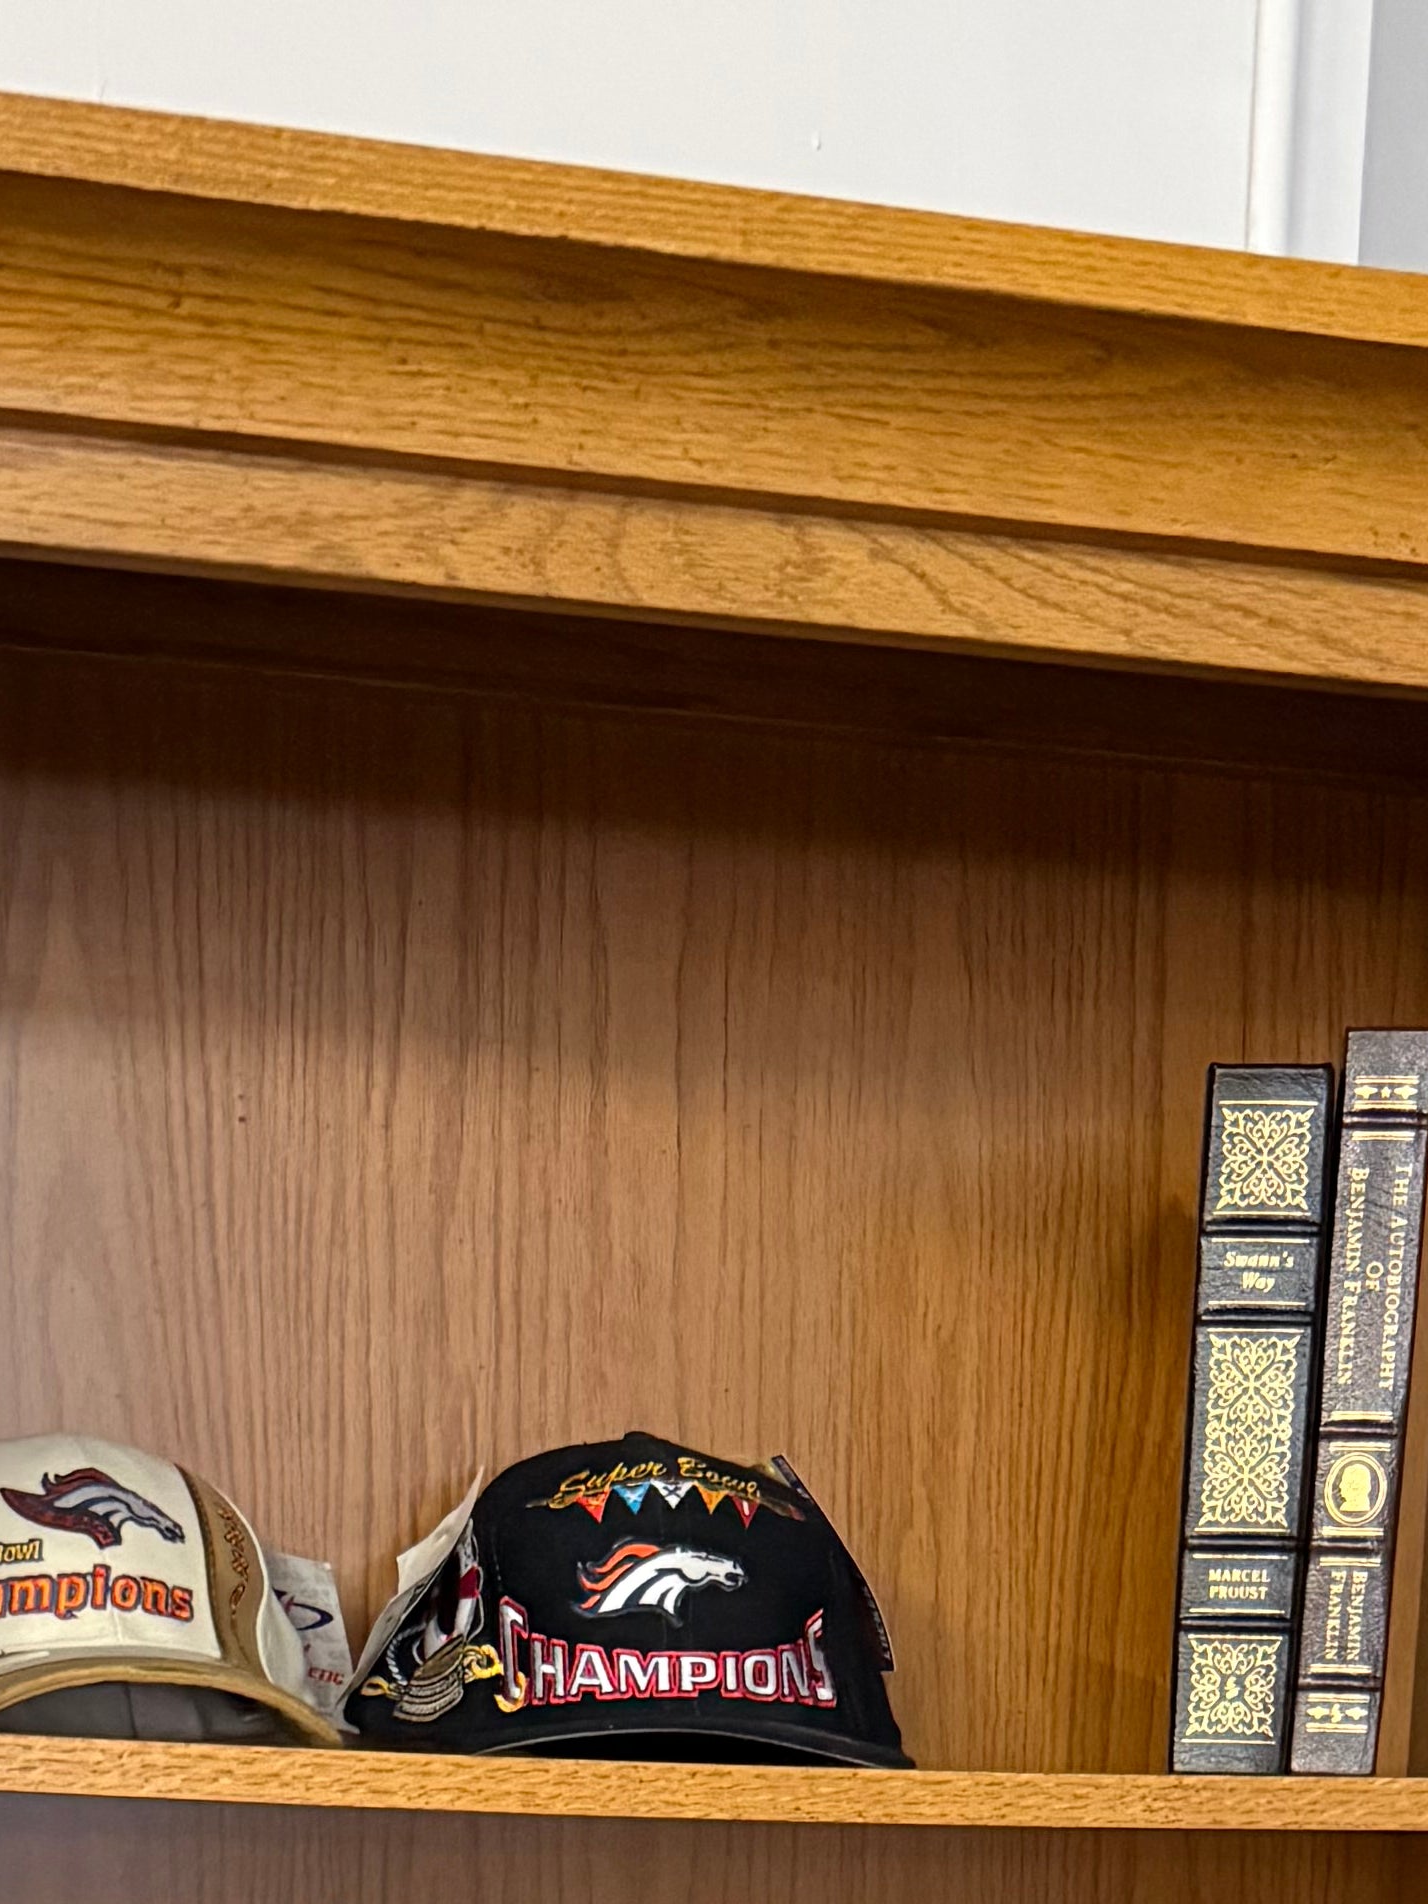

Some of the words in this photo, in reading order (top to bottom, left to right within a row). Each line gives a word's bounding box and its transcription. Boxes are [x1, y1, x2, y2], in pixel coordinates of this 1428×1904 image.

[1393, 1166, 1413, 1207] THE
[1345, 1167, 1370, 1272] BENJAMIN
[1224, 1250, 1294, 1269] Swann's
[1242, 1271, 1276, 1293] Way
[1365, 1261, 1384, 1291] OF
[1378, 1215, 1409, 1392] AUTOBIOGRAPHY
[1337, 1280, 1362, 1386] FRANKLIN
[549, 1461, 667, 1509] Super
[1208, 1569, 1271, 1583] MARCEL
[1209, 1586, 1269, 1600] PROUST
[1325, 1571, 1347, 1661] FRANKLIN
[1346, 1571, 1369, 1661] BENJAMIN
[498, 1595, 837, 1709] CHAMPIONS
